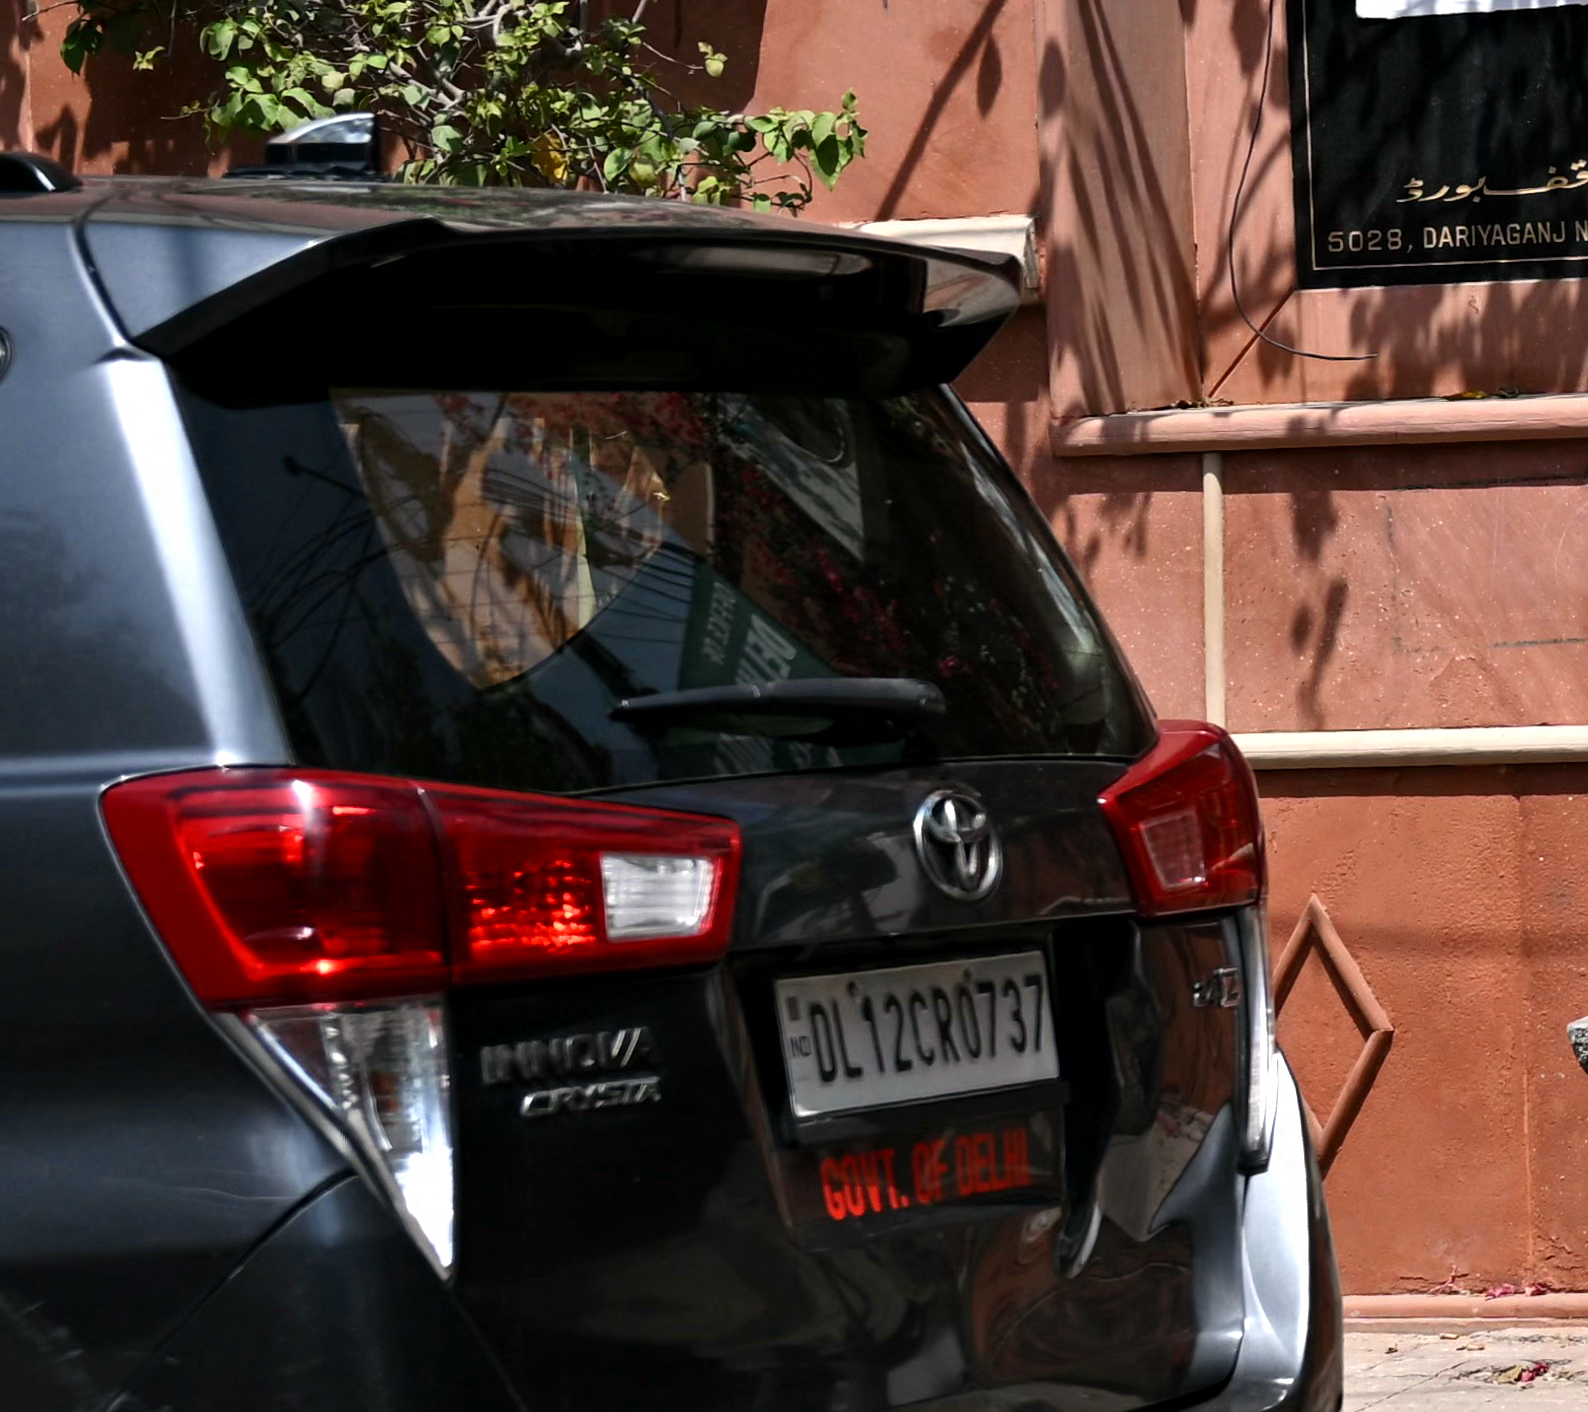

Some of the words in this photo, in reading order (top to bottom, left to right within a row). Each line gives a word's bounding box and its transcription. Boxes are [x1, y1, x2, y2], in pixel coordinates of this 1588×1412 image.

[1423, 221, 1566, 249] DARIYAGANJ
[810, 974, 1042, 1082] DL12CR0737
[520, 1076, 662, 1118] CRYSTA
[820, 1148, 910, 1220] GOVT.
[912, 1138, 949, 1204] OF
[955, 1127, 1032, 1196] DELHI
